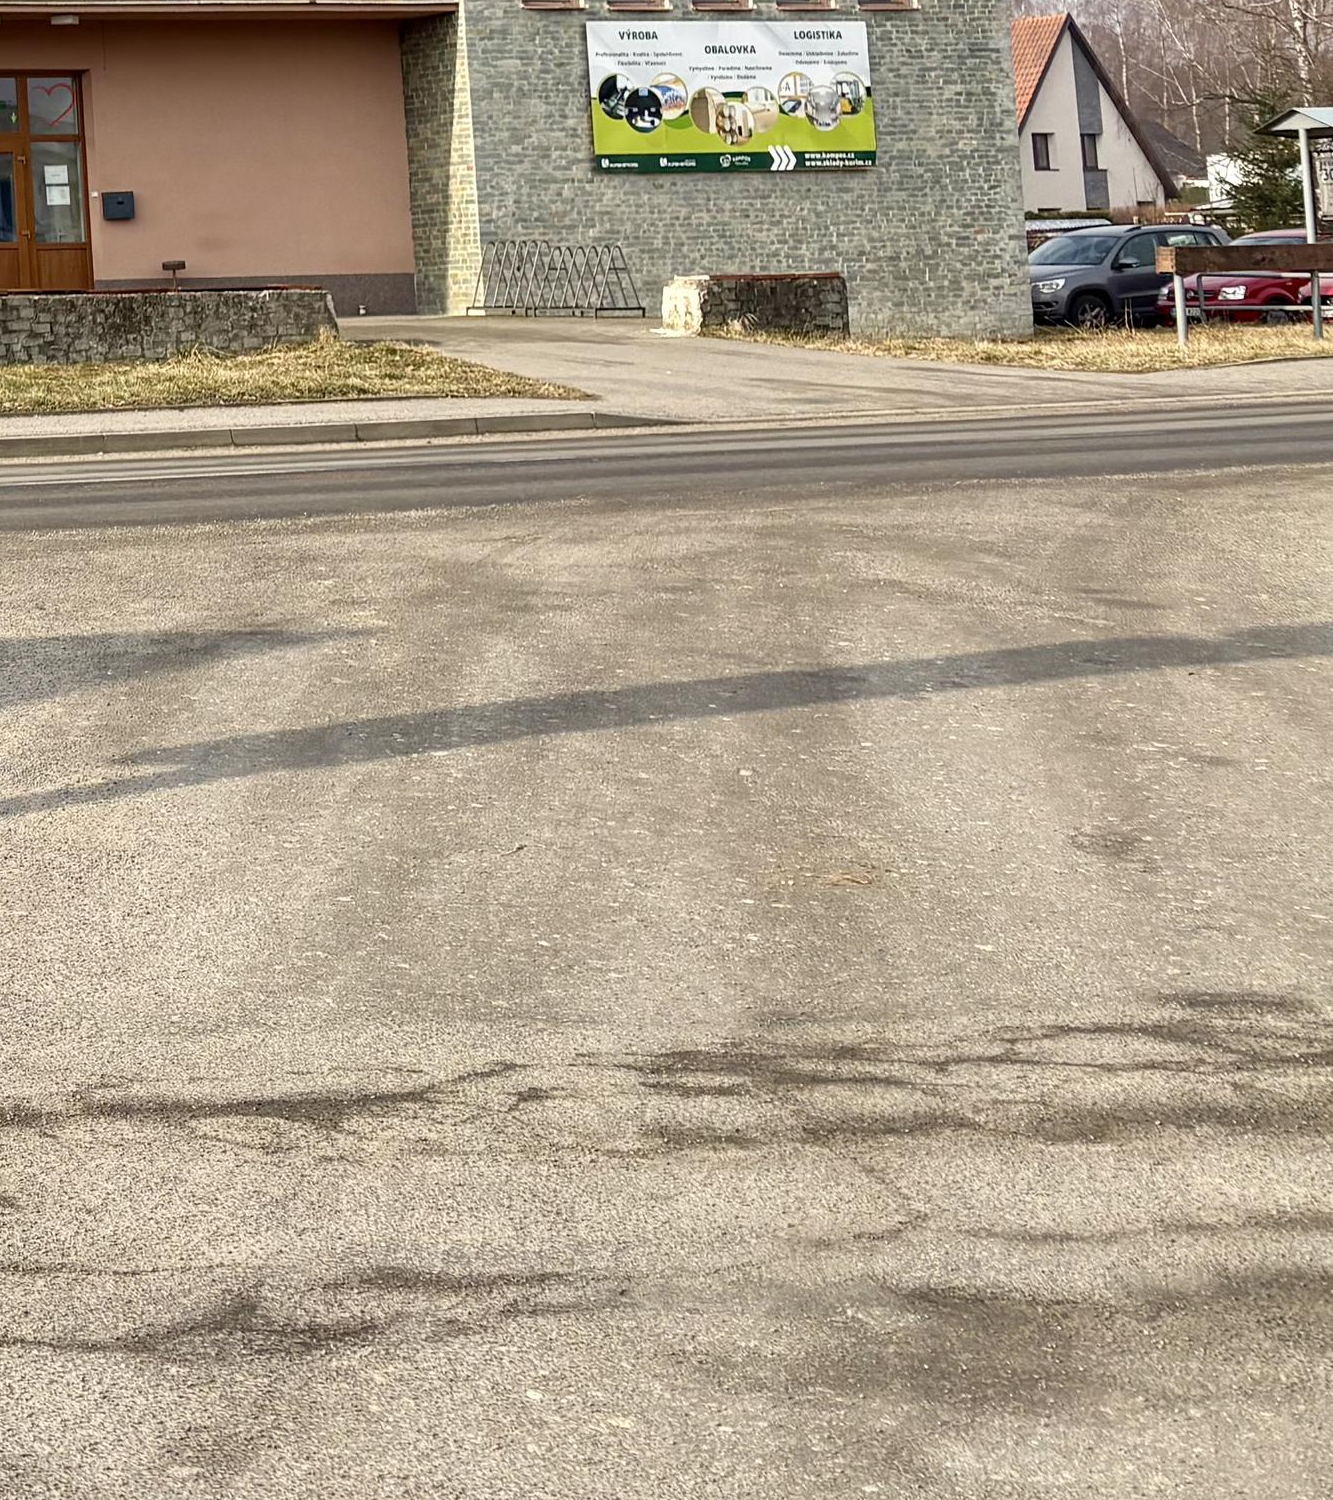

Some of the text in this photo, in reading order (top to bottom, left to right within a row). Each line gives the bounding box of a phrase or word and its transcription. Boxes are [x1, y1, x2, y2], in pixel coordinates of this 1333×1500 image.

[618, 28, 659, 41] VÝROBA
[793, 30, 843, 40] LOGISTIKA
[704, 45, 757, 55] OBALOVKA
